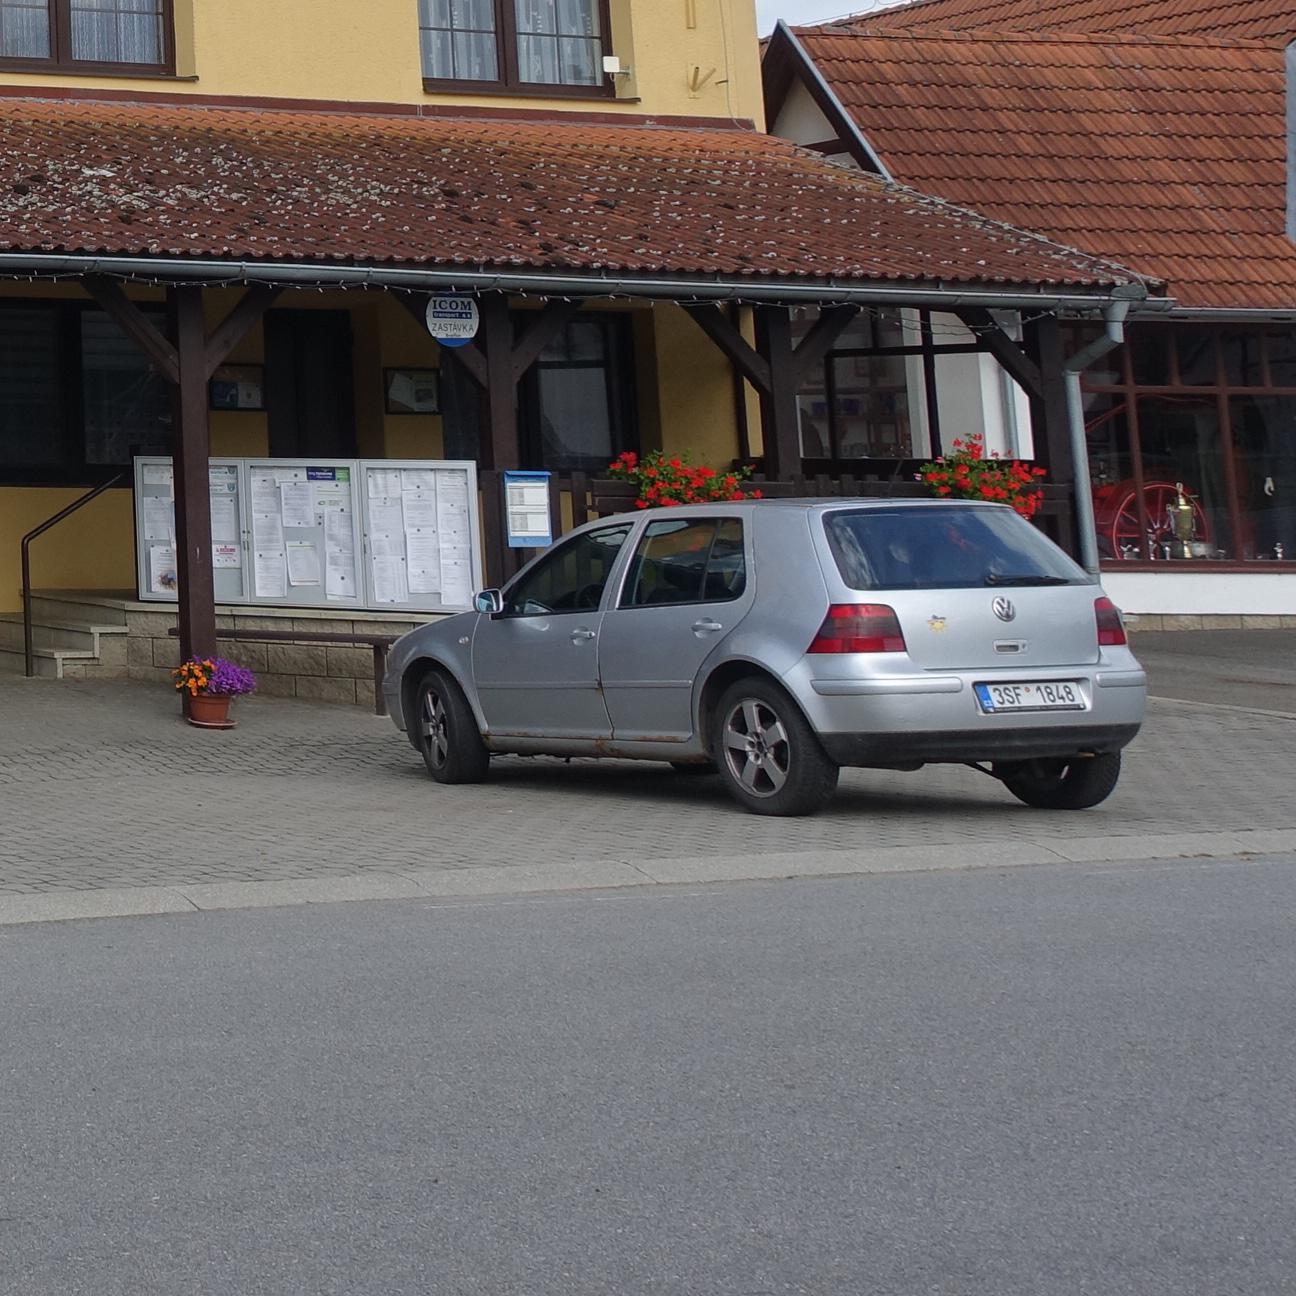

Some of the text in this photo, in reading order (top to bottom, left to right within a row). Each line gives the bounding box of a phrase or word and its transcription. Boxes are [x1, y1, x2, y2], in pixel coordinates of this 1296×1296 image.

[432, 300, 472, 311] ICOM
[432, 322, 474, 333] ZASTÁVKA
[993, 684, 1076, 705] 3SF 1848
